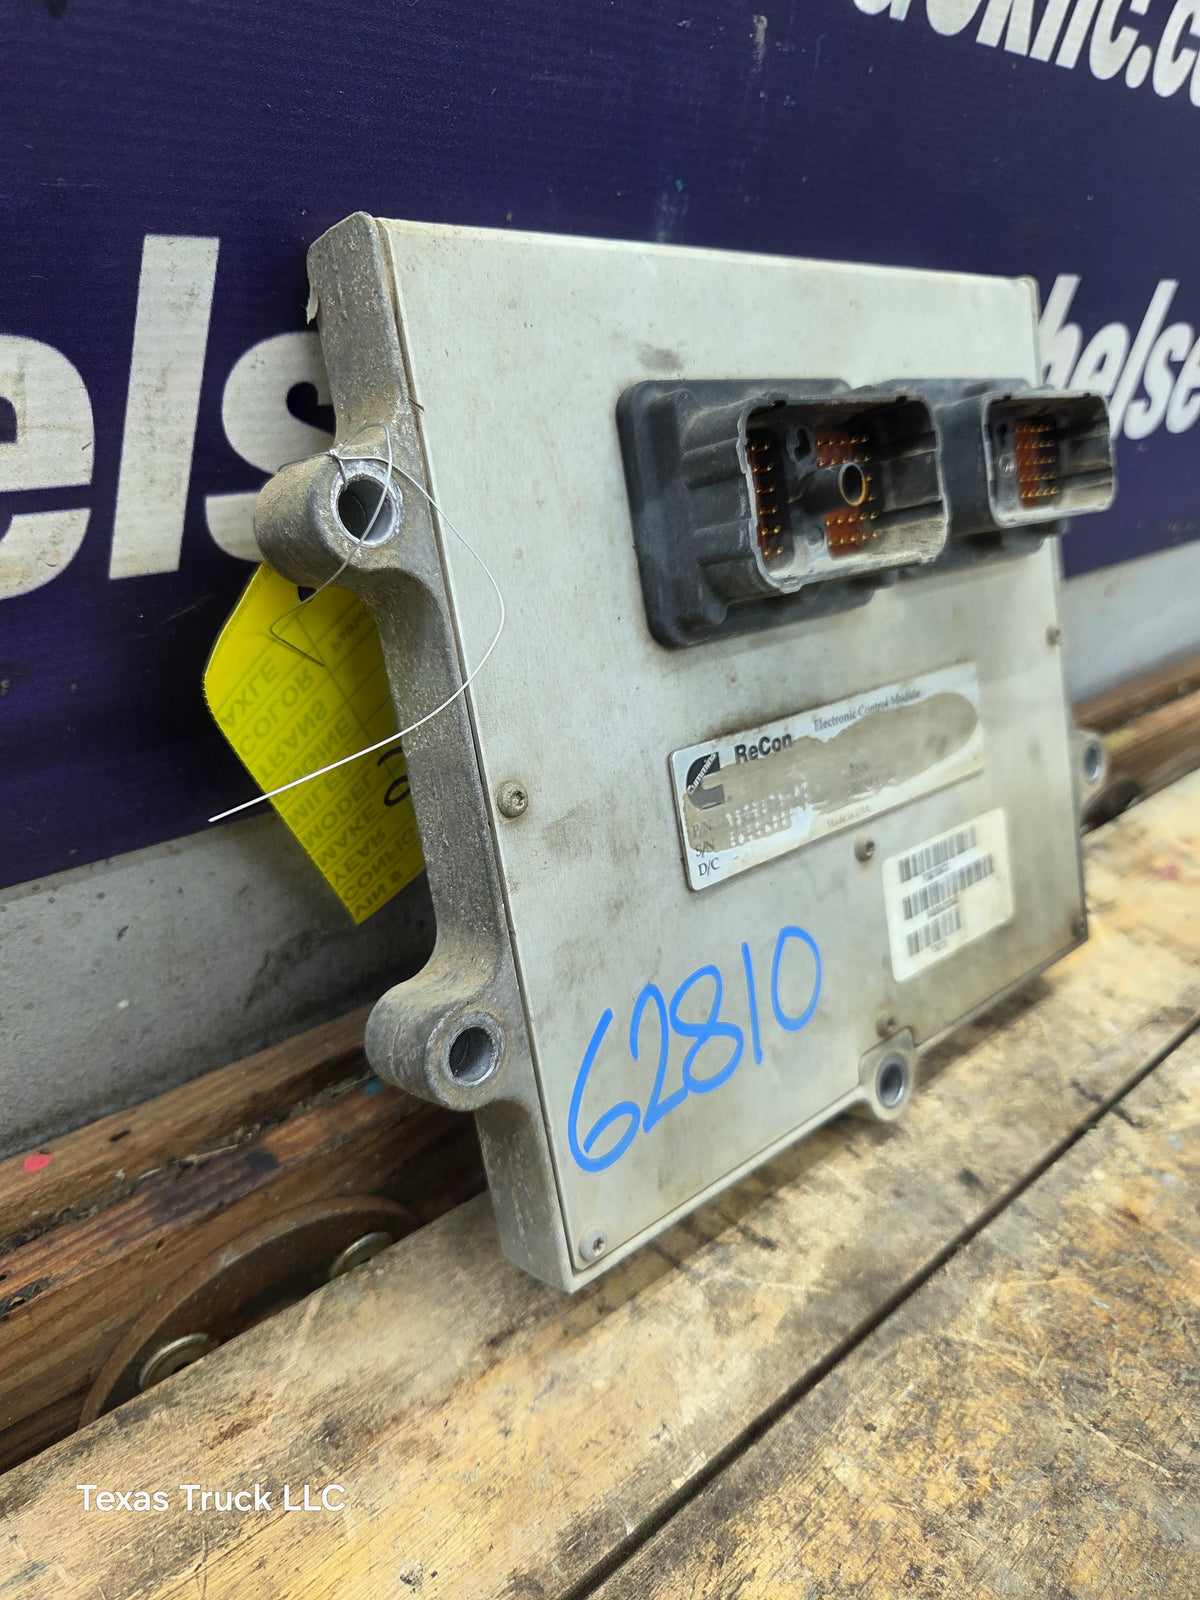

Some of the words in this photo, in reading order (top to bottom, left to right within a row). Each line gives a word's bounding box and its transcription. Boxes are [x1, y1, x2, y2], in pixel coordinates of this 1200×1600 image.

[813, 708, 856, 733] Electronic
[733, 733, 793, 764] ReCon
[686, 751, 717, 796] Cummins
[697, 857, 720, 877] D/C
[567, 925, 822, 1173] 62810
